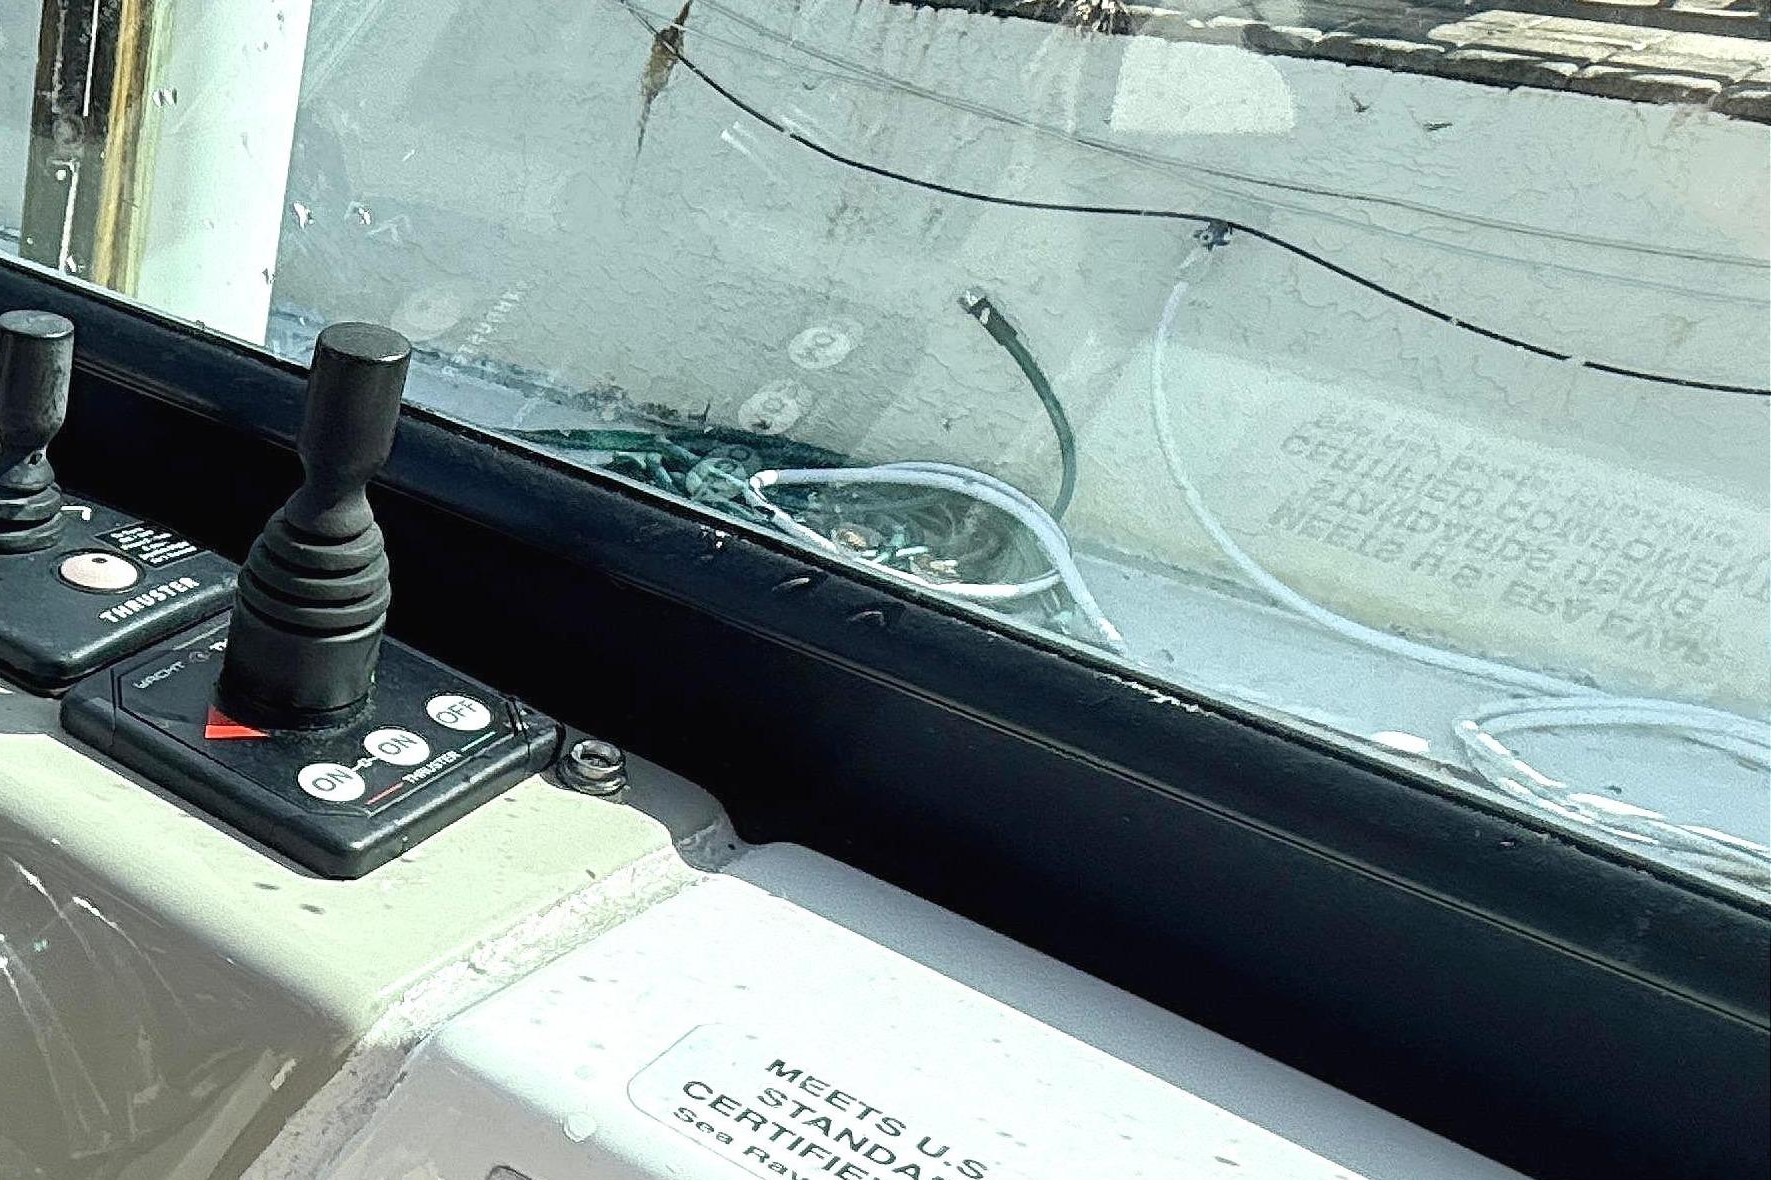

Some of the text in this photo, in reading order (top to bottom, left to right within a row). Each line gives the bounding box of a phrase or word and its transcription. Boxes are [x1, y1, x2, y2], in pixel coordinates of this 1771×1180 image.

[99, 576, 199, 625] THRUSTER
[435, 698, 479, 724] OFF
[378, 734, 418, 756] ON
[311, 767, 354, 792] ON
[400, 750, 461, 785] THRUSTER
[765, 1059, 907, 1137] MEETS
